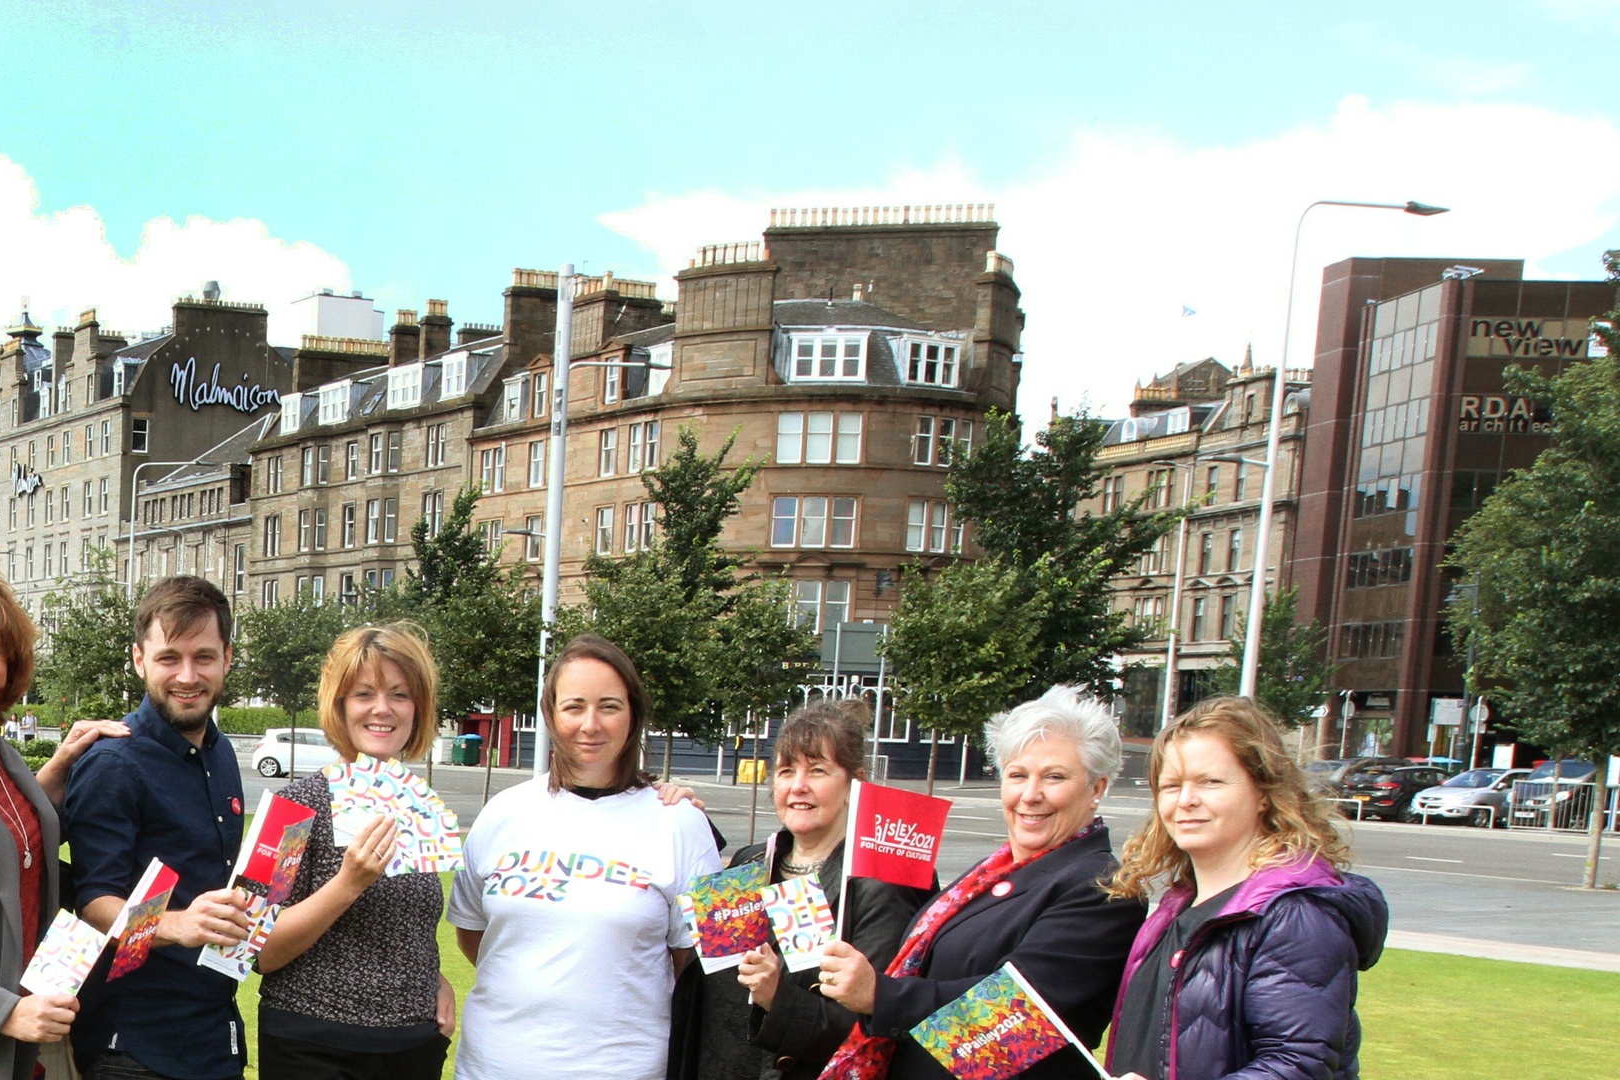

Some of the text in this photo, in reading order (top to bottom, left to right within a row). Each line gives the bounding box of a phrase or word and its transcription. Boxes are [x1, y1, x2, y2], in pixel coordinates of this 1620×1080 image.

[1470, 318, 1542, 338] new
[1502, 337, 1584, 357] view
[170, 356, 283, 413] Malmaison
[908, 832, 936, 850] 2021
[256, 847, 273, 859] FOR
[878, 845, 896, 855] CITY
[896, 848, 906, 857] OF
[905, 850, 932, 862] CULTURE
[493, 850, 653, 890] DUNDEE
[485, 872, 570, 902] 2023
[956, 1011, 1027, 1058] #Paisley2021
